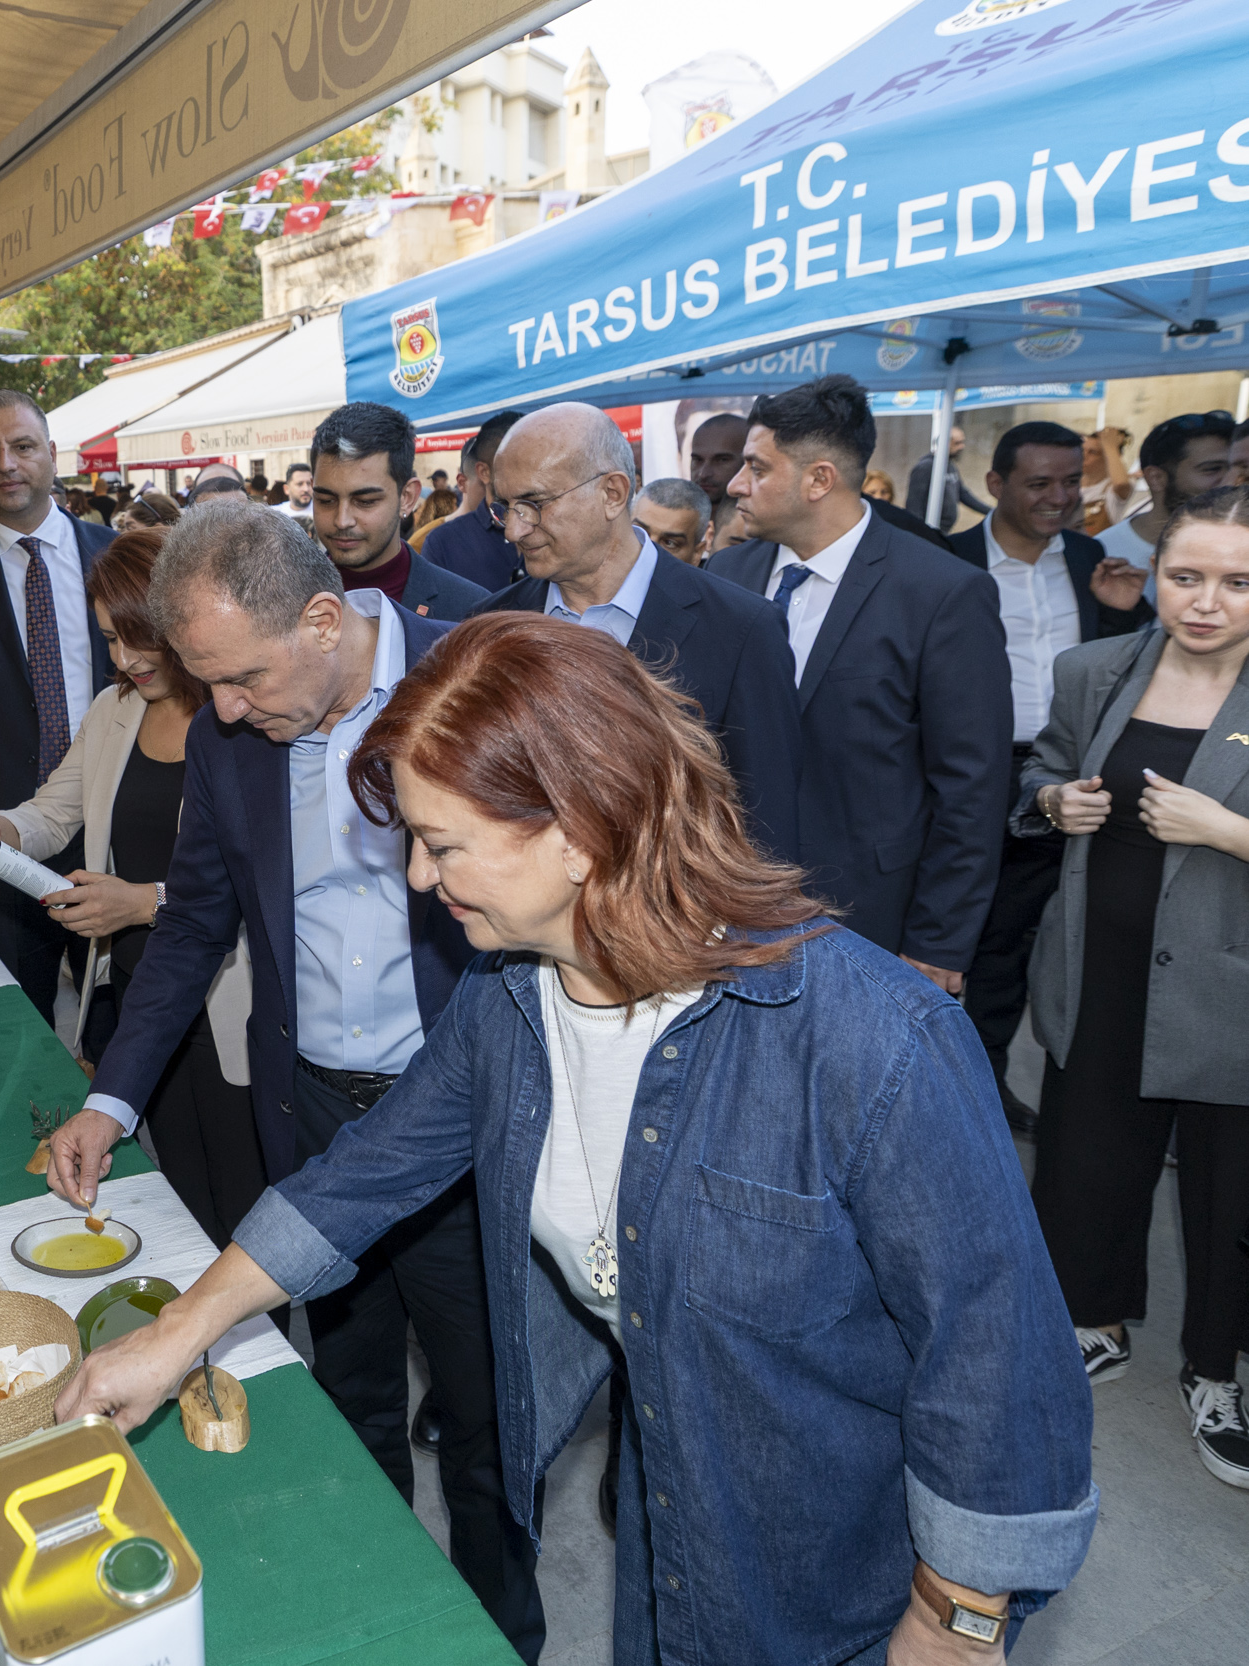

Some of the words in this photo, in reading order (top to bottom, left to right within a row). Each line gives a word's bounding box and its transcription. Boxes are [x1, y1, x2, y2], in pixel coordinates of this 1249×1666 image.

[739, 141, 869, 230] T.C.
[396, 298, 431, 328] TARSUS
[507, 258, 721, 370] TARSUS
[200, 431, 222, 450] Slow
